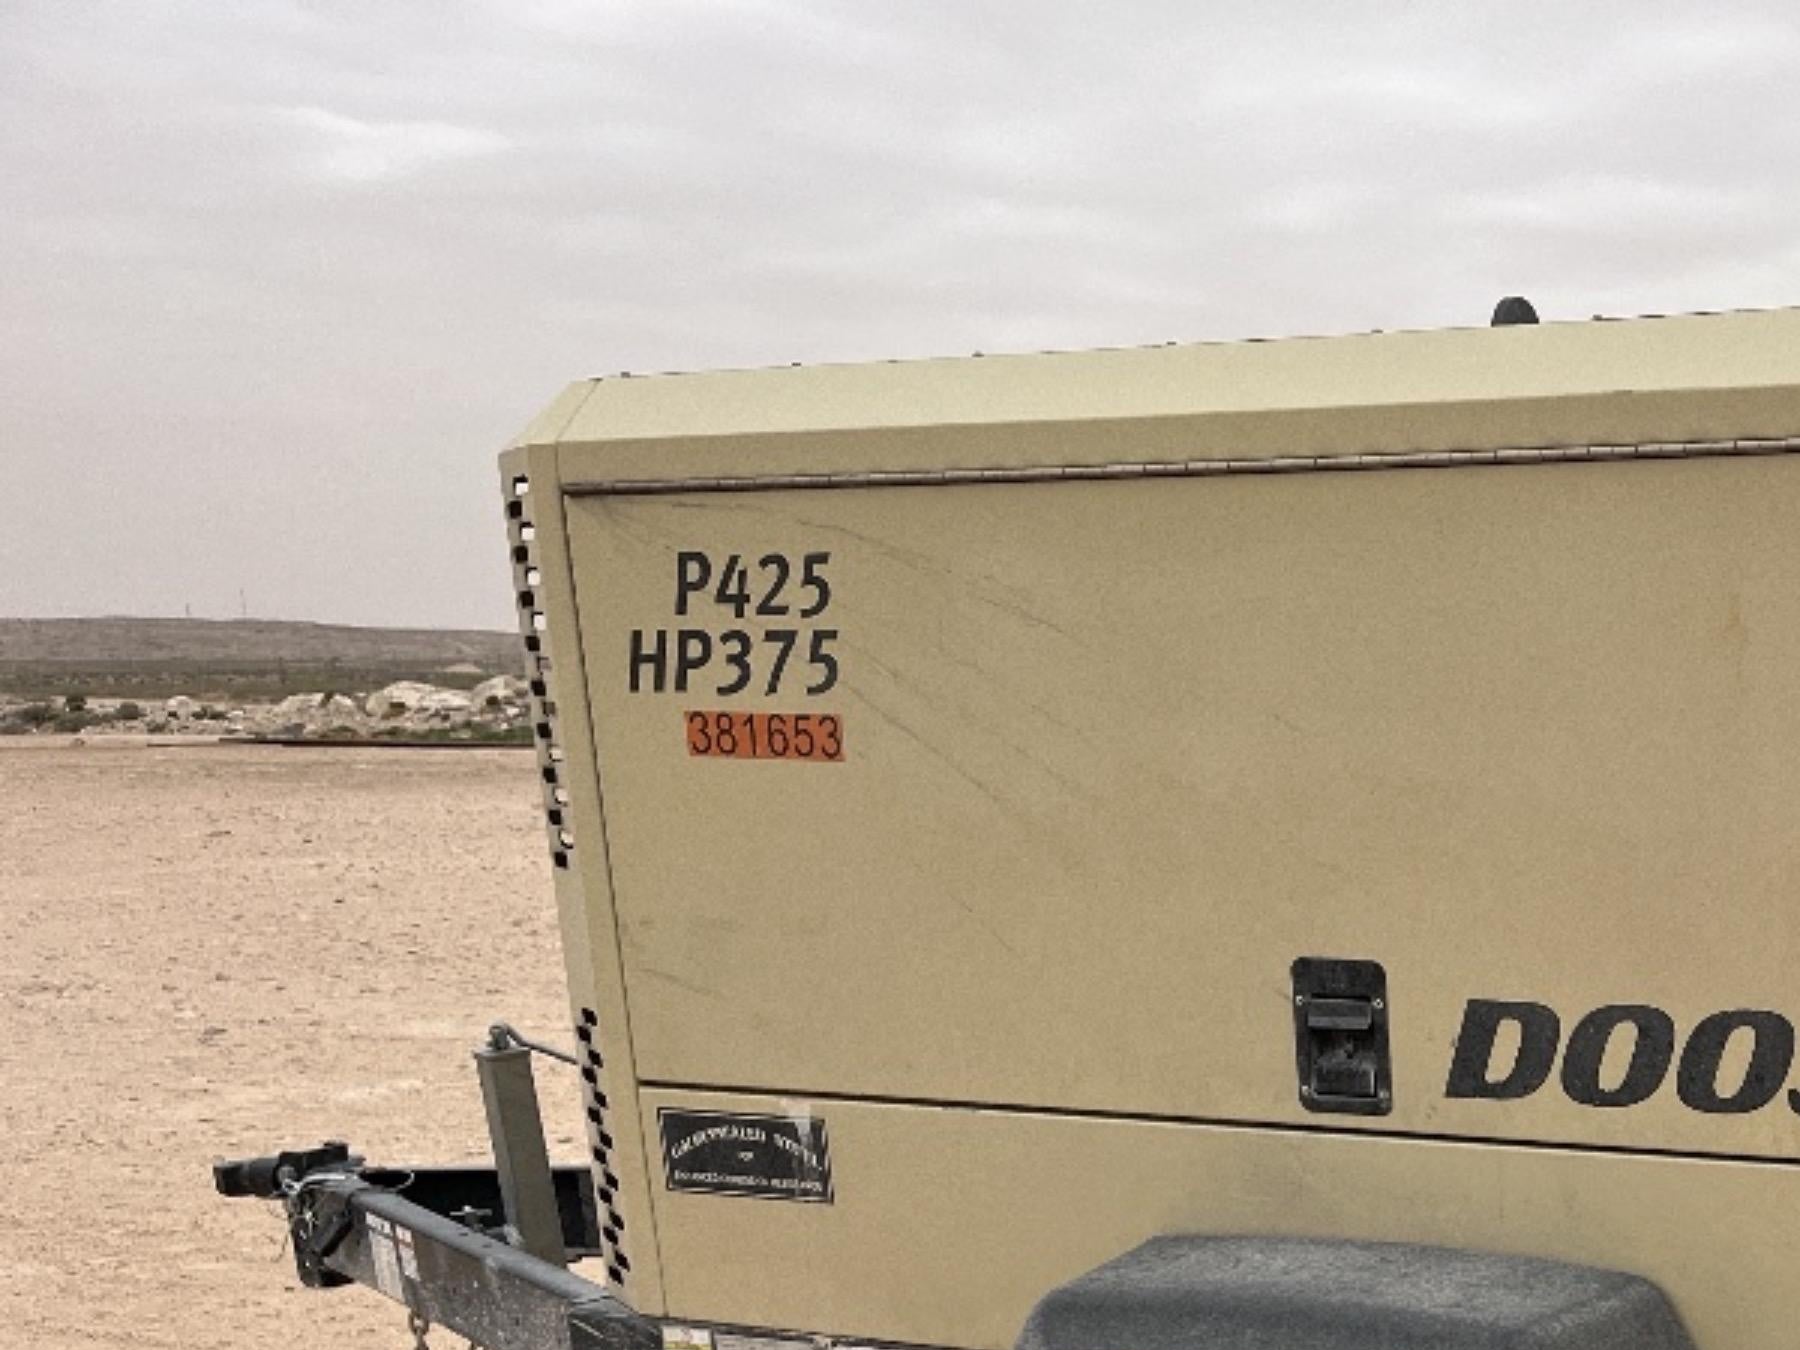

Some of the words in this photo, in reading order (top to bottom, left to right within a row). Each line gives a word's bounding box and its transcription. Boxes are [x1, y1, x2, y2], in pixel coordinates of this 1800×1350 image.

[674, 551, 832, 618] P425
[629, 628, 839, 696] HP375
[689, 712, 842, 758] 381653
